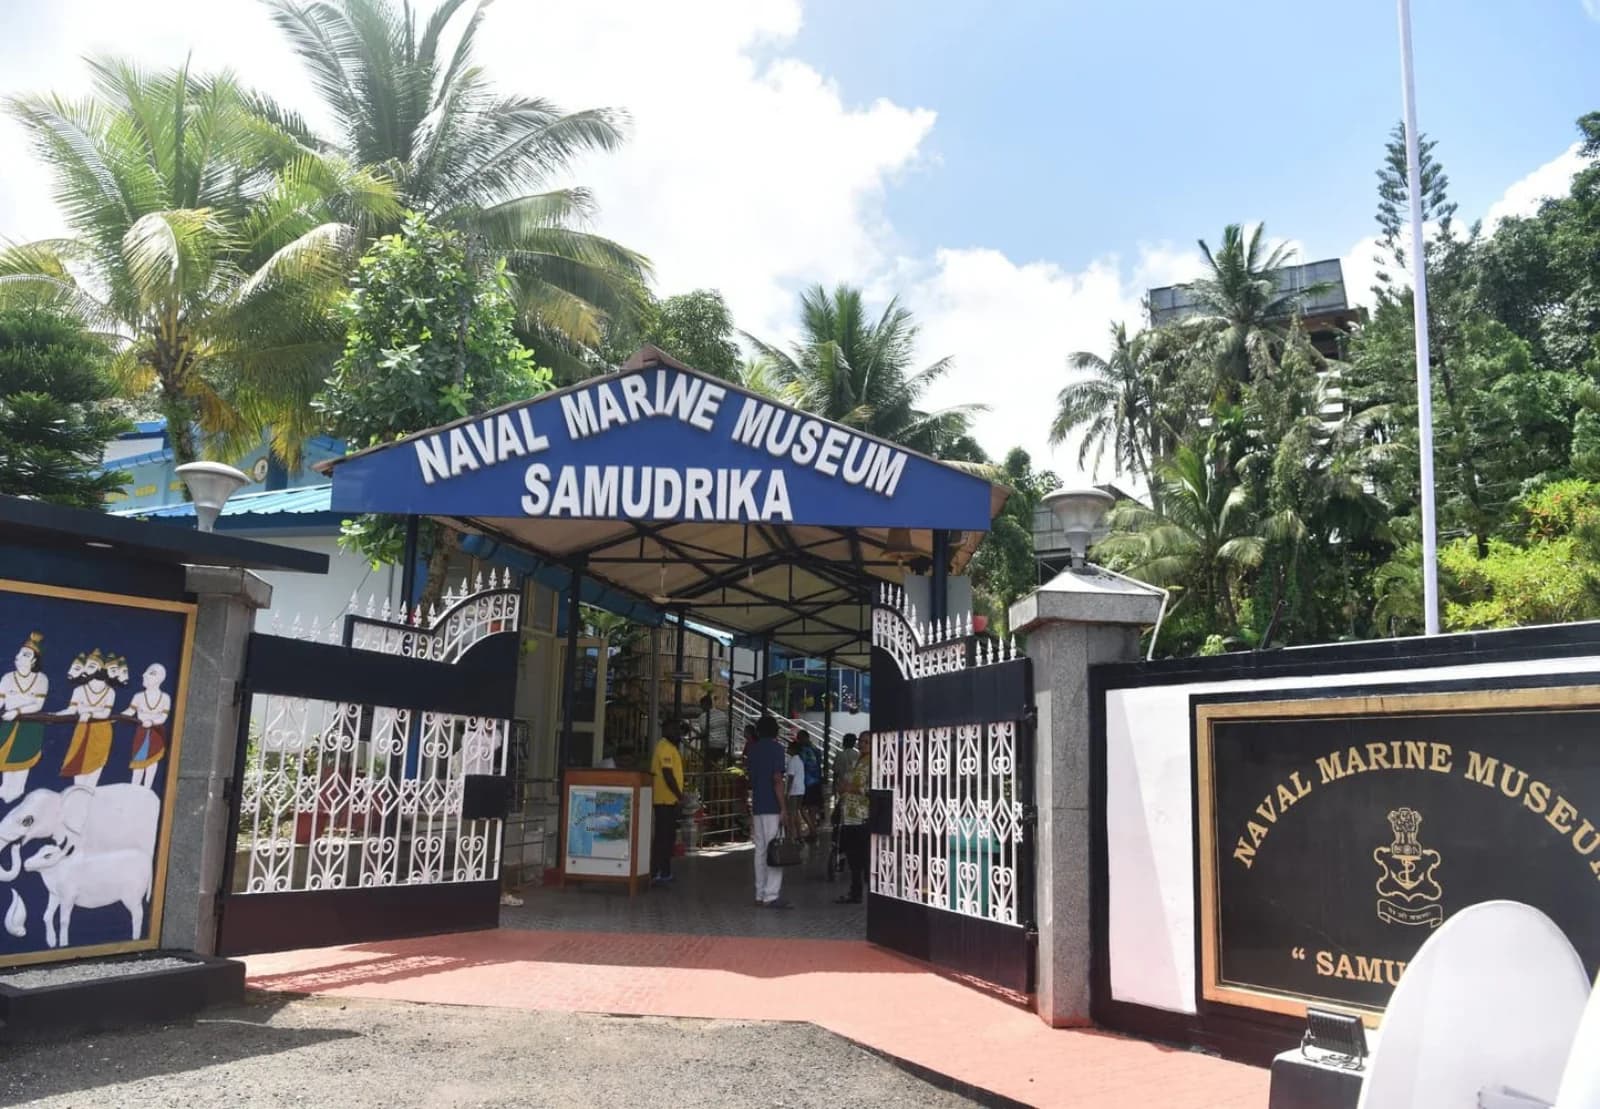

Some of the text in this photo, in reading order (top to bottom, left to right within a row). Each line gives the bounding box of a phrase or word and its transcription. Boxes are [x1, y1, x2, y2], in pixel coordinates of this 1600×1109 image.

[415, 369, 907, 497] NAVAL MARINE MUSEUM
[521, 463, 793, 521] SAMUDRIKA
[1233, 771, 1312, 869] NAVAL
[1317, 741, 1452, 784] MARINE
[1316, 950, 1408, 987] SAMU
